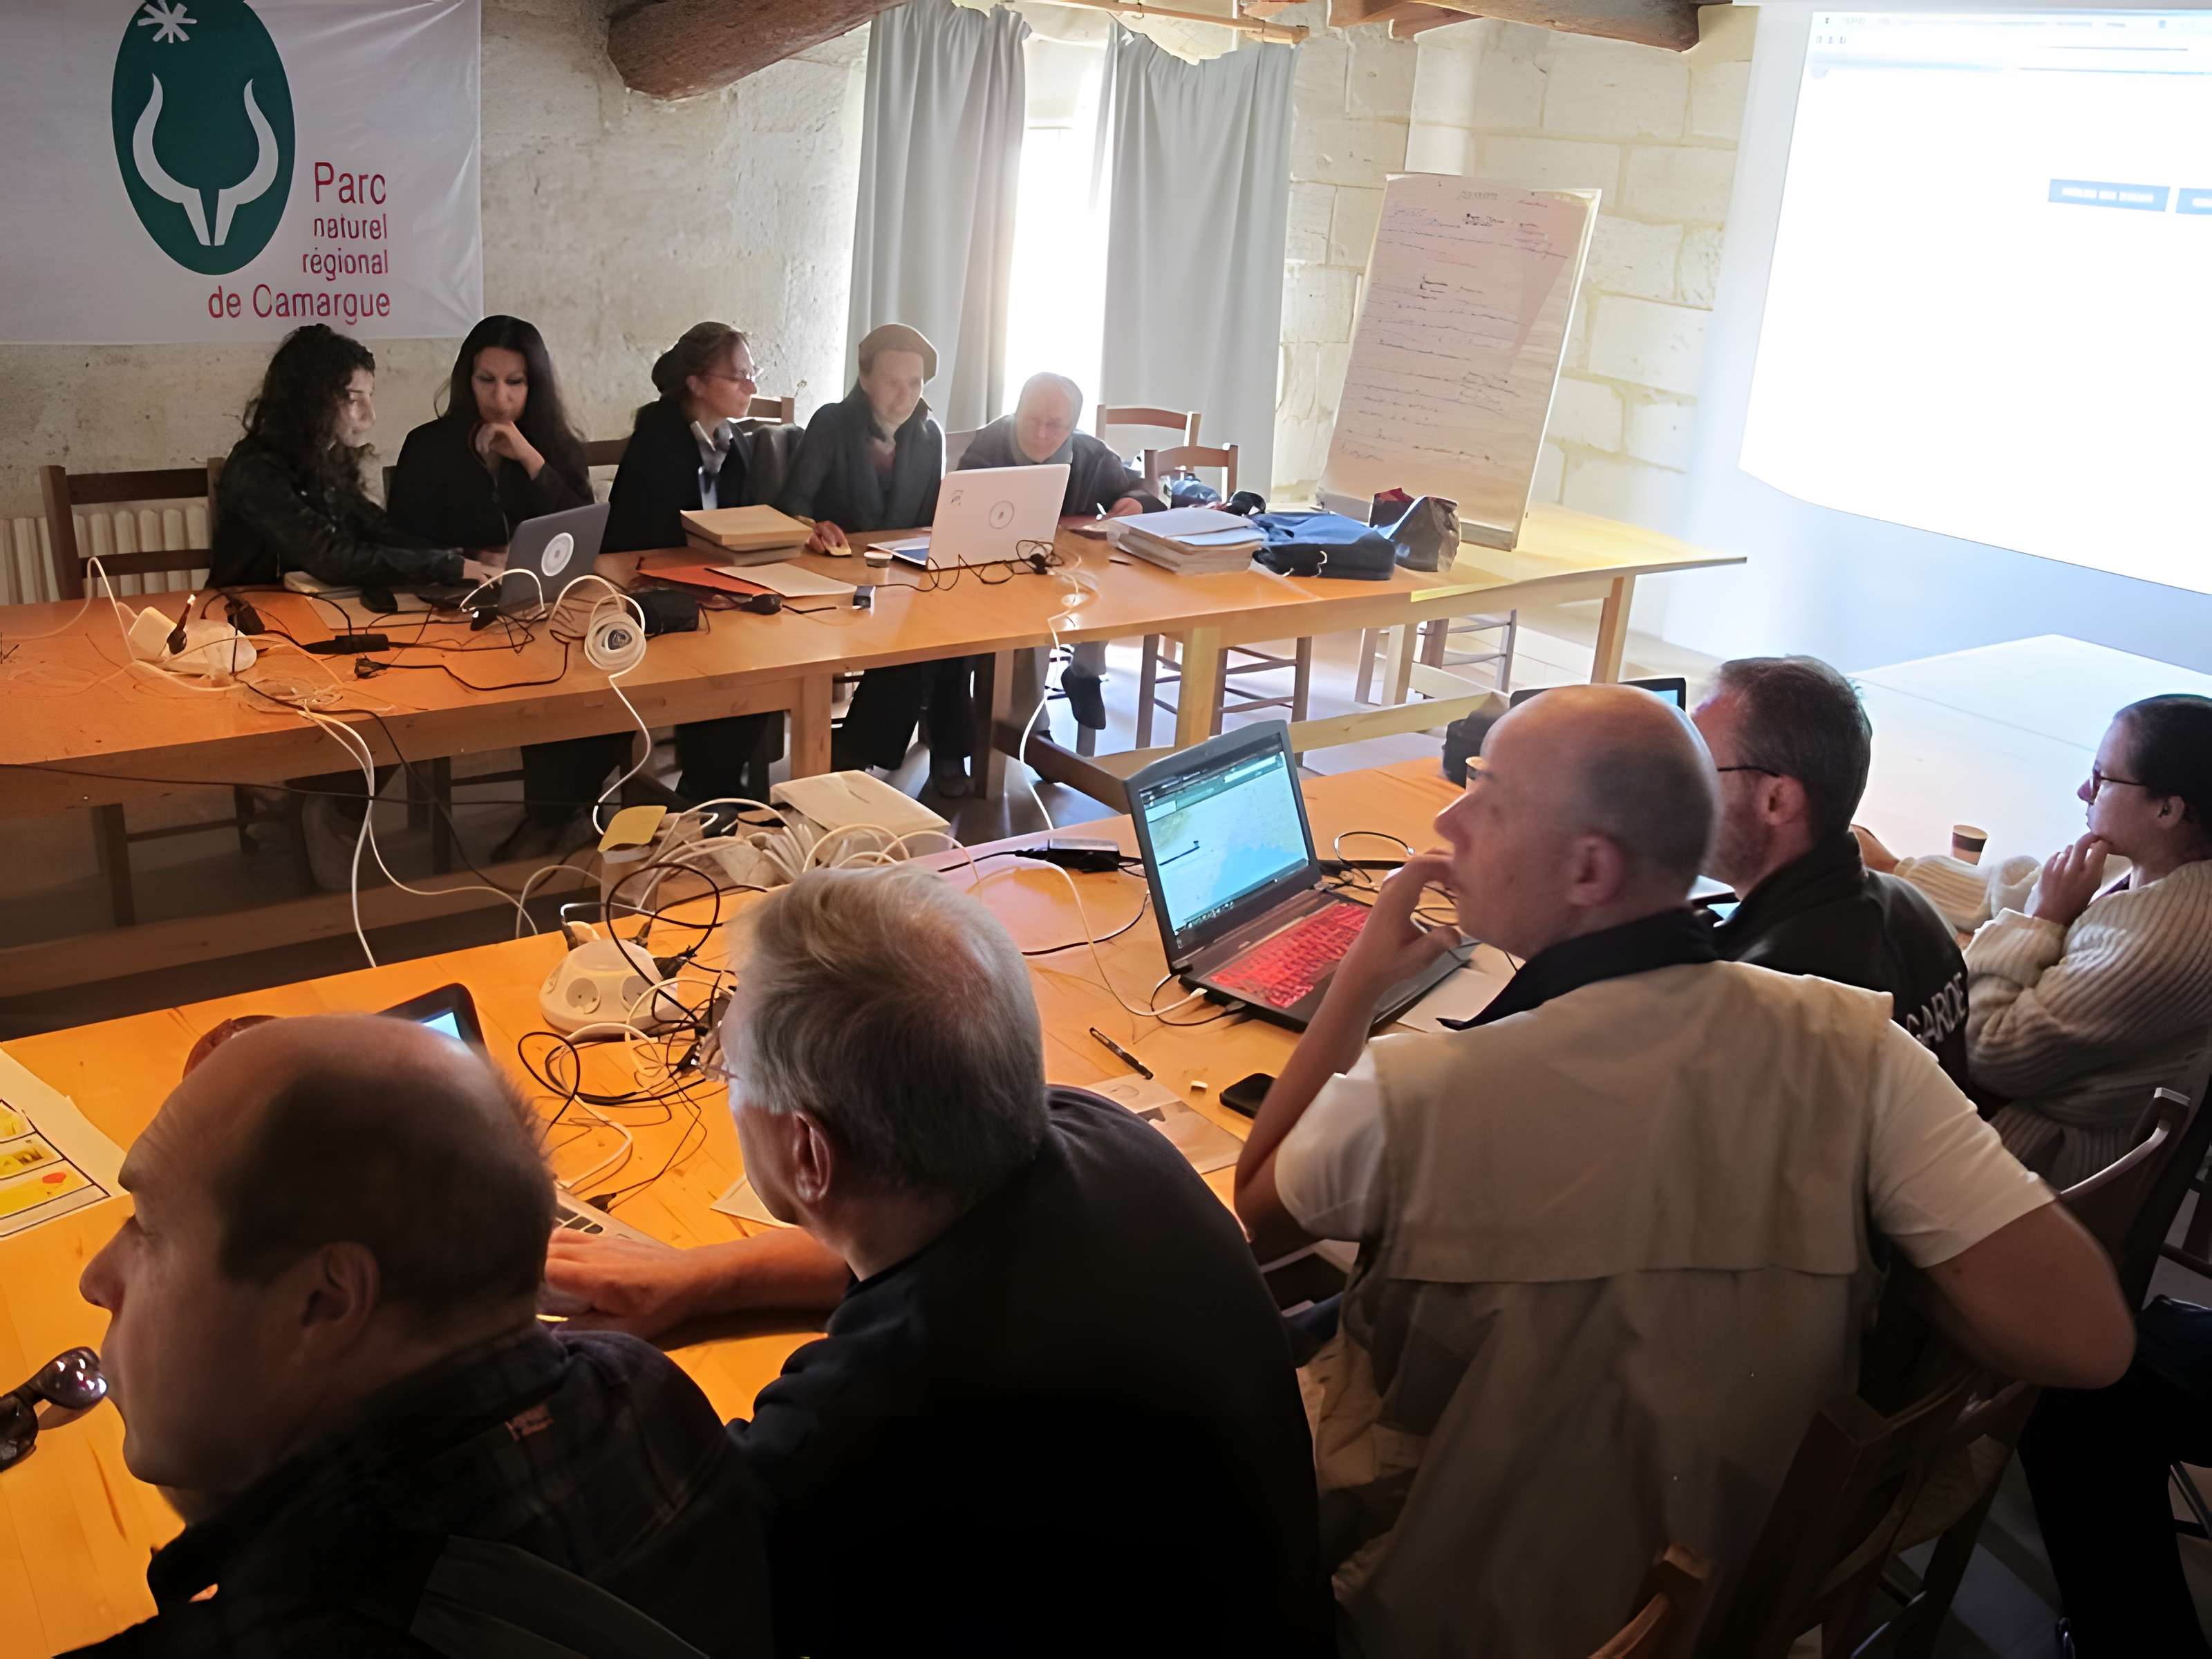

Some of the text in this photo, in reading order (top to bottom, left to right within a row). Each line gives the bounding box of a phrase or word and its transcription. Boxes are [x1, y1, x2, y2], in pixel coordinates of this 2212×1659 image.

[314, 162, 386, 205] Parc
[313, 213, 388, 240] naturel
[302, 247, 388, 282] régional
[208, 283, 391, 326] de Camargue
